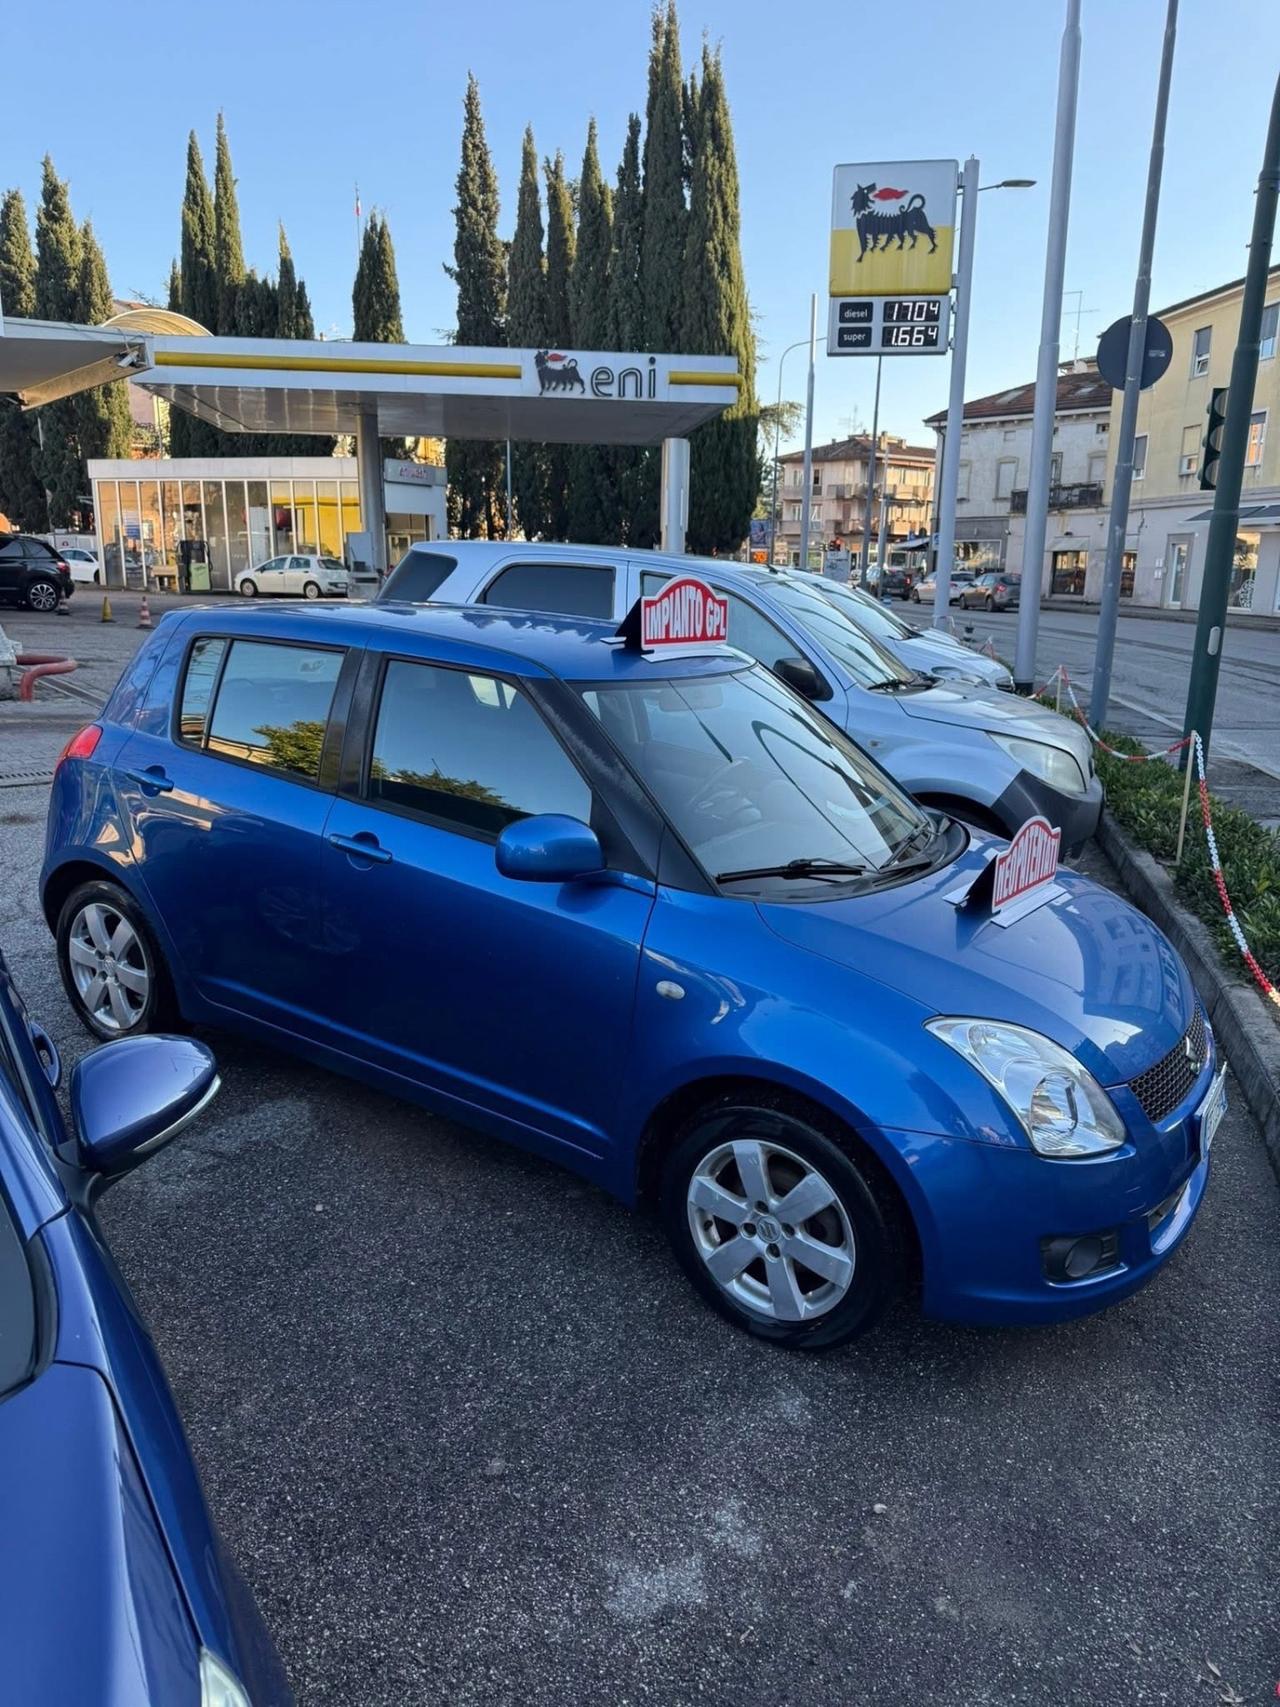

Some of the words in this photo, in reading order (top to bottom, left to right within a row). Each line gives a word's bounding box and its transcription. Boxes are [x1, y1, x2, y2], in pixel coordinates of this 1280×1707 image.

[844, 309, 868, 319] diesel
[843, 332, 867, 342] super
[591, 356, 656, 398] eni
[646, 585, 703, 639] IMPIANTO
[706, 597, 726, 638] GPL
[997, 824, 1058, 901] NEOPATENTATI
